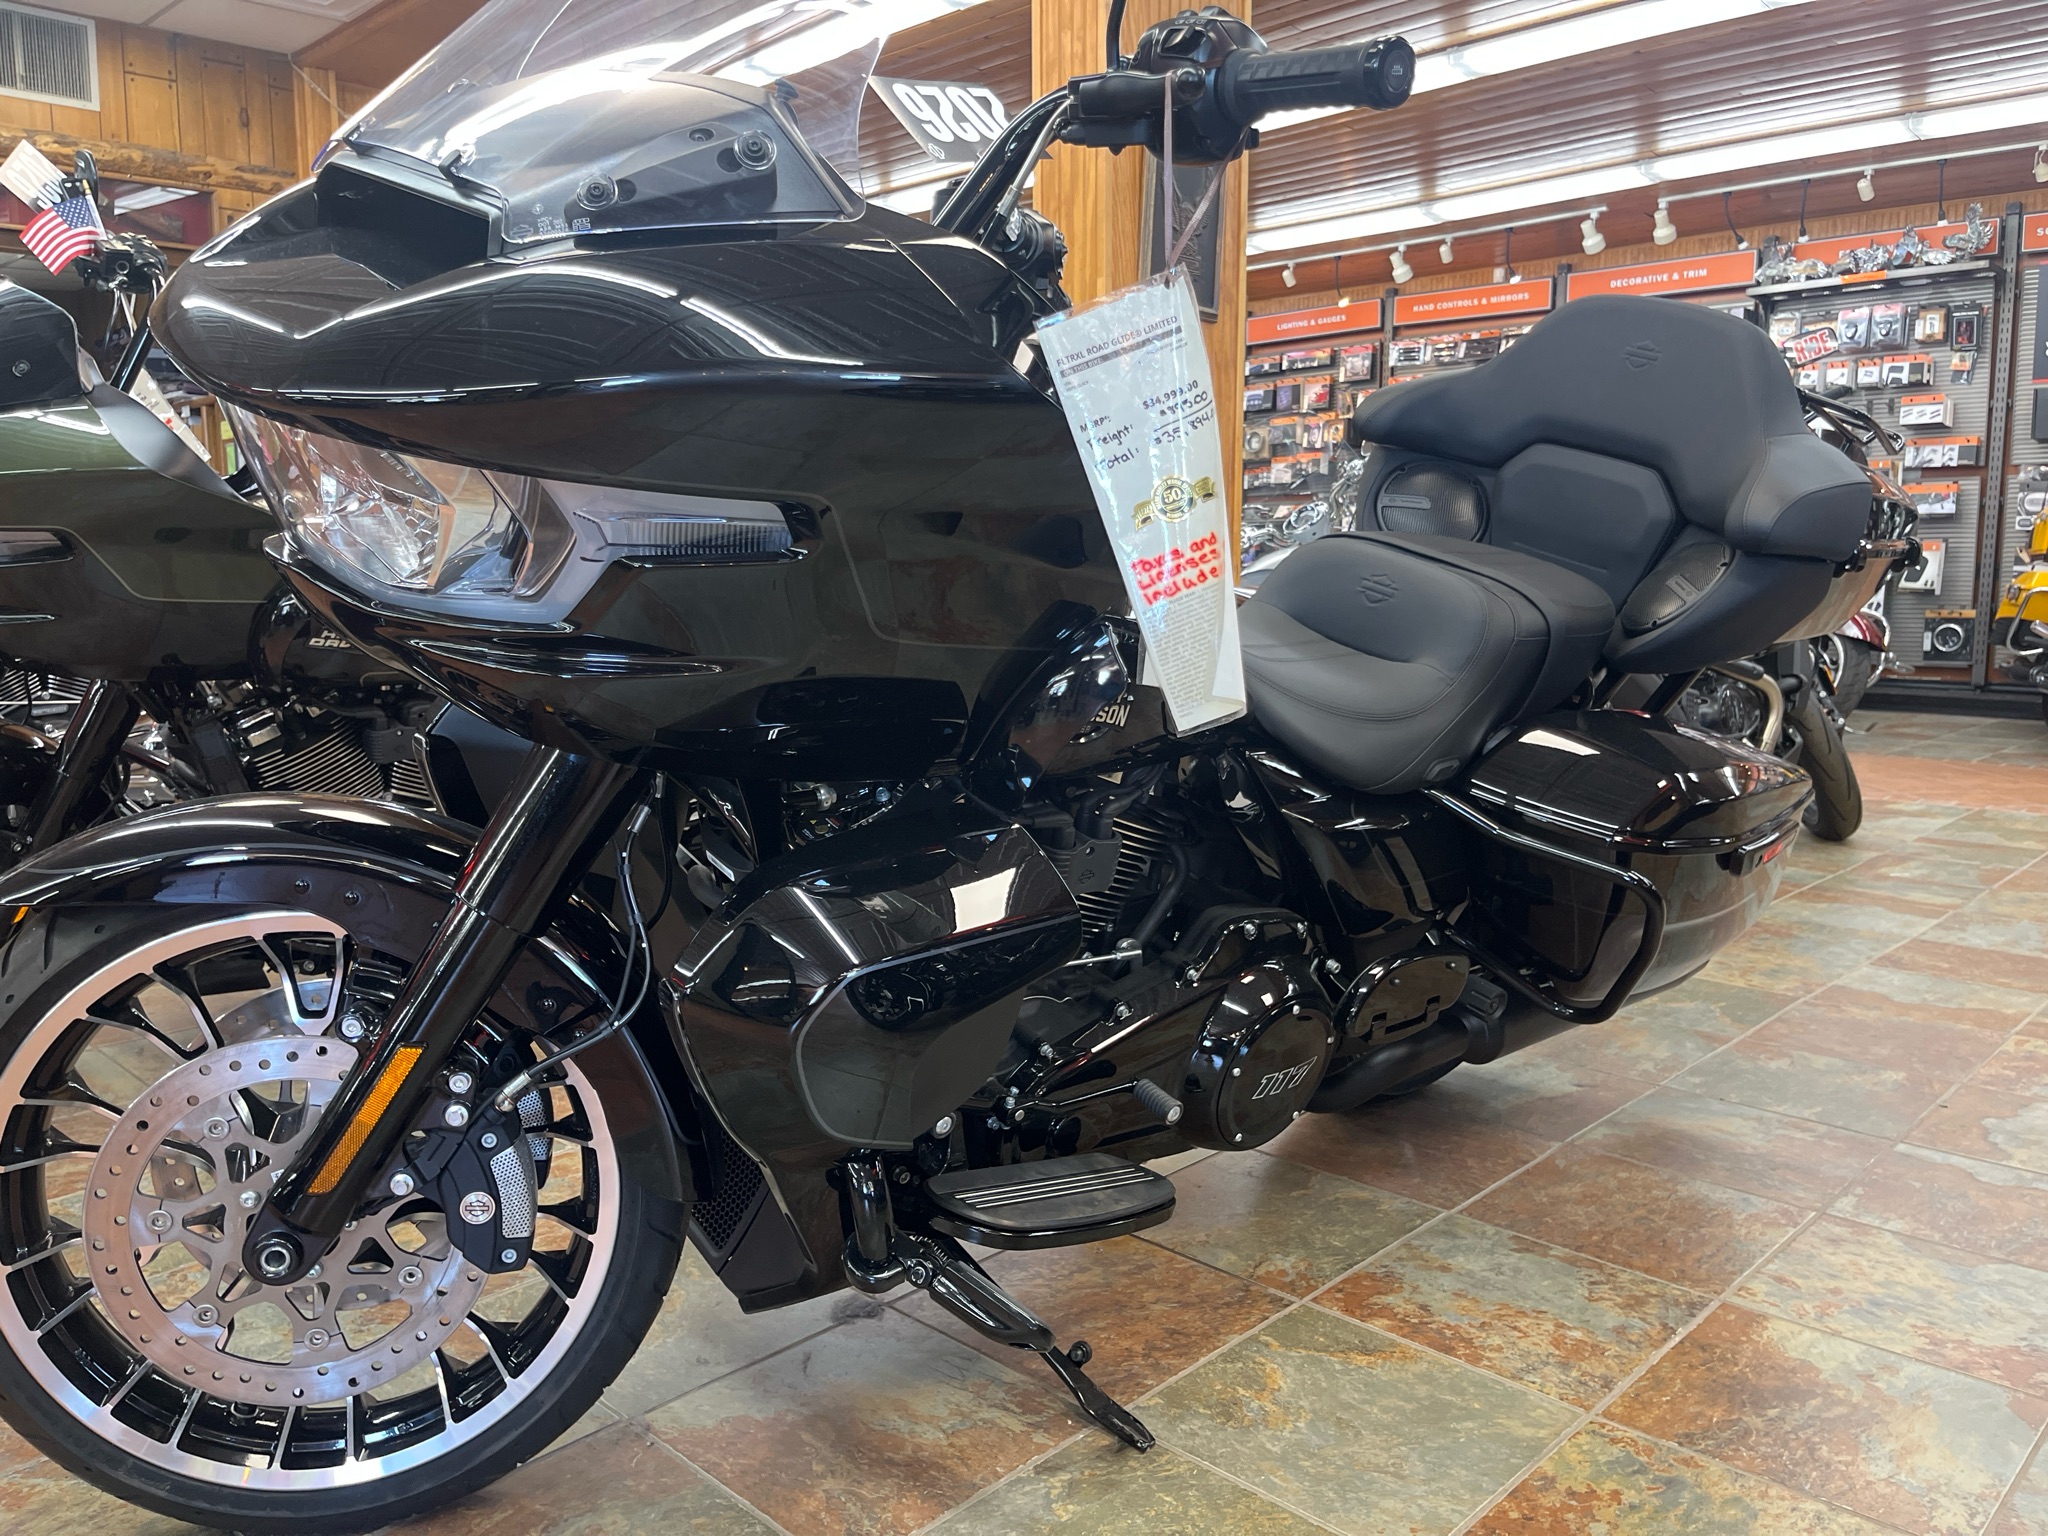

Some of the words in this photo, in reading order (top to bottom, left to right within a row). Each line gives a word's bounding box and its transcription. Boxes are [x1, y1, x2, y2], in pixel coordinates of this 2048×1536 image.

[1610, 273, 1669, 288] DECORATIVE
[1672, 272, 1679, 280] &
[1683, 268, 1708, 279] TRIM
[1413, 303, 1434, 312] HAND
[1436, 298, 1479, 310] CONTROLS
[1481, 297, 1487, 305] &
[1490, 292, 1529, 304] MIRRORS
[1277, 319, 1309, 331] LIGHTING
[1310, 318, 1316, 326] &
[1318, 314, 1347, 325] GAUGES
[1087, 341, 1110, 356] ROAD
[1144, 316, 1178, 335] LIMITED
[1190, 532, 1217, 552] and
[1090, 705, 1131, 728] SON
[1251, 1056, 1318, 1100] 117
